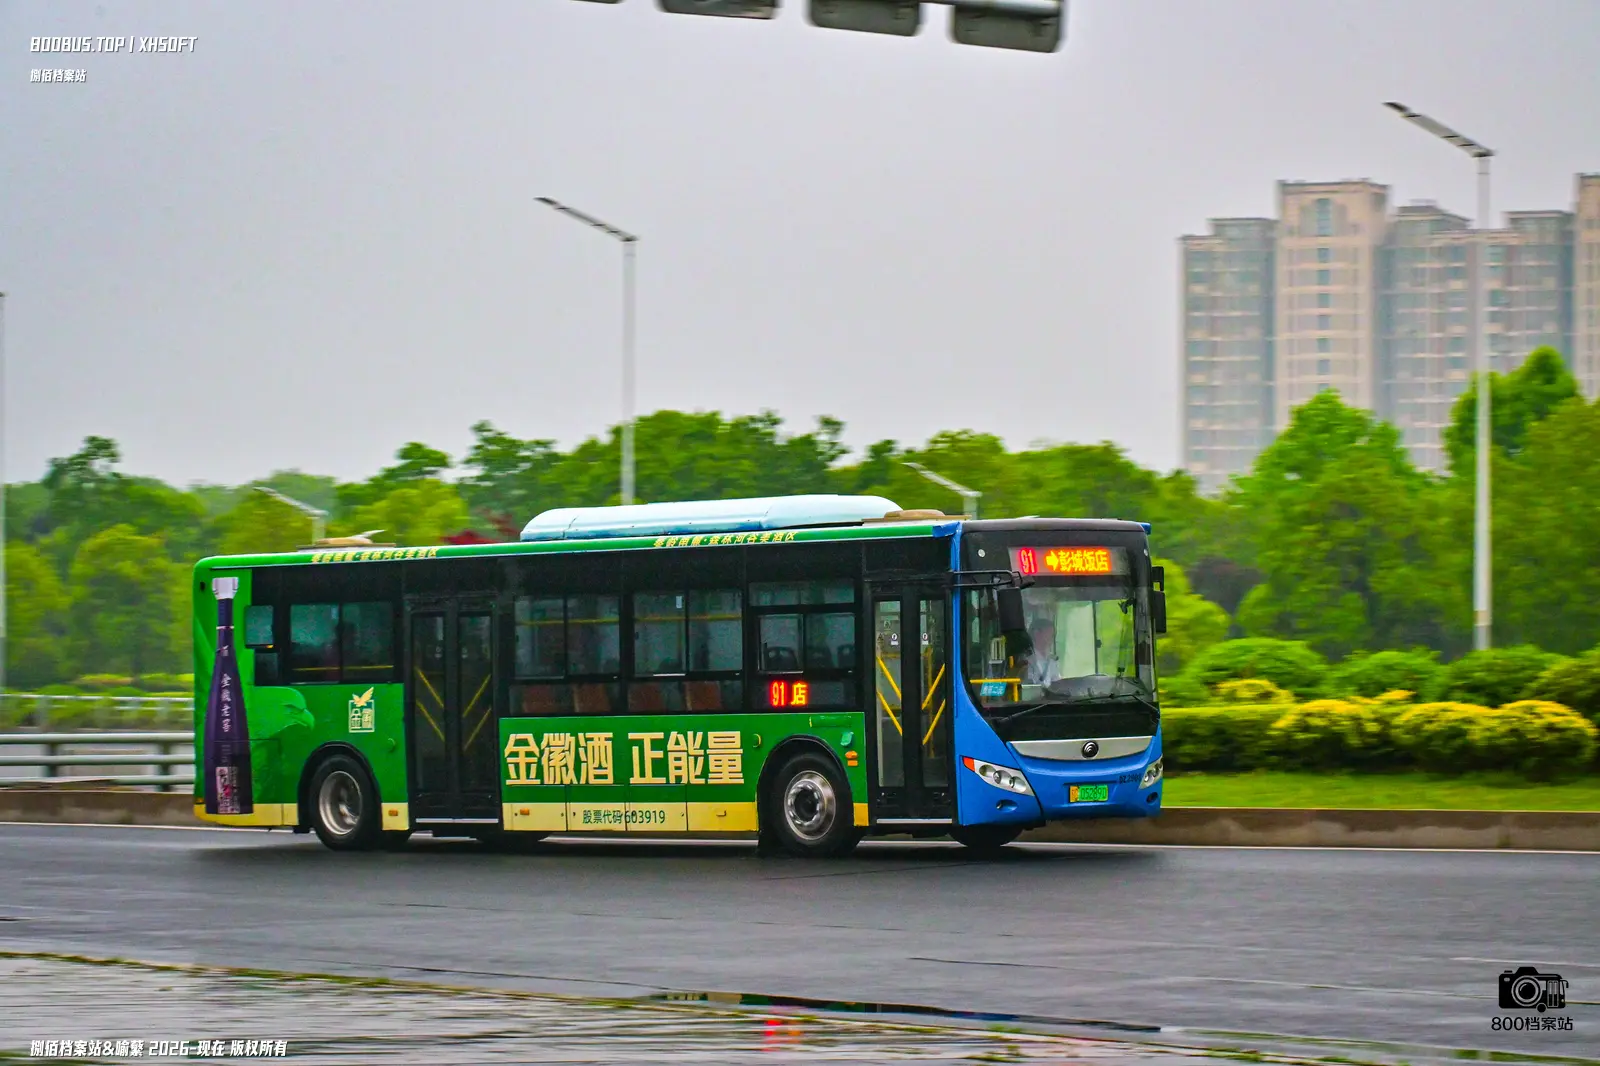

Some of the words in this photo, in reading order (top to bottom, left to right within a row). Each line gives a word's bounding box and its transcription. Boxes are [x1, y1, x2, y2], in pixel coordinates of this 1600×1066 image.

[1019, 548, 1038, 574] 91
[1058, 550, 1109, 572] 彭城饭店
[771, 681, 786, 707] 91
[790, 682, 808, 705] 店
[504, 732, 614, 785] 金徽酒
[627, 731, 745, 785] 正能量
